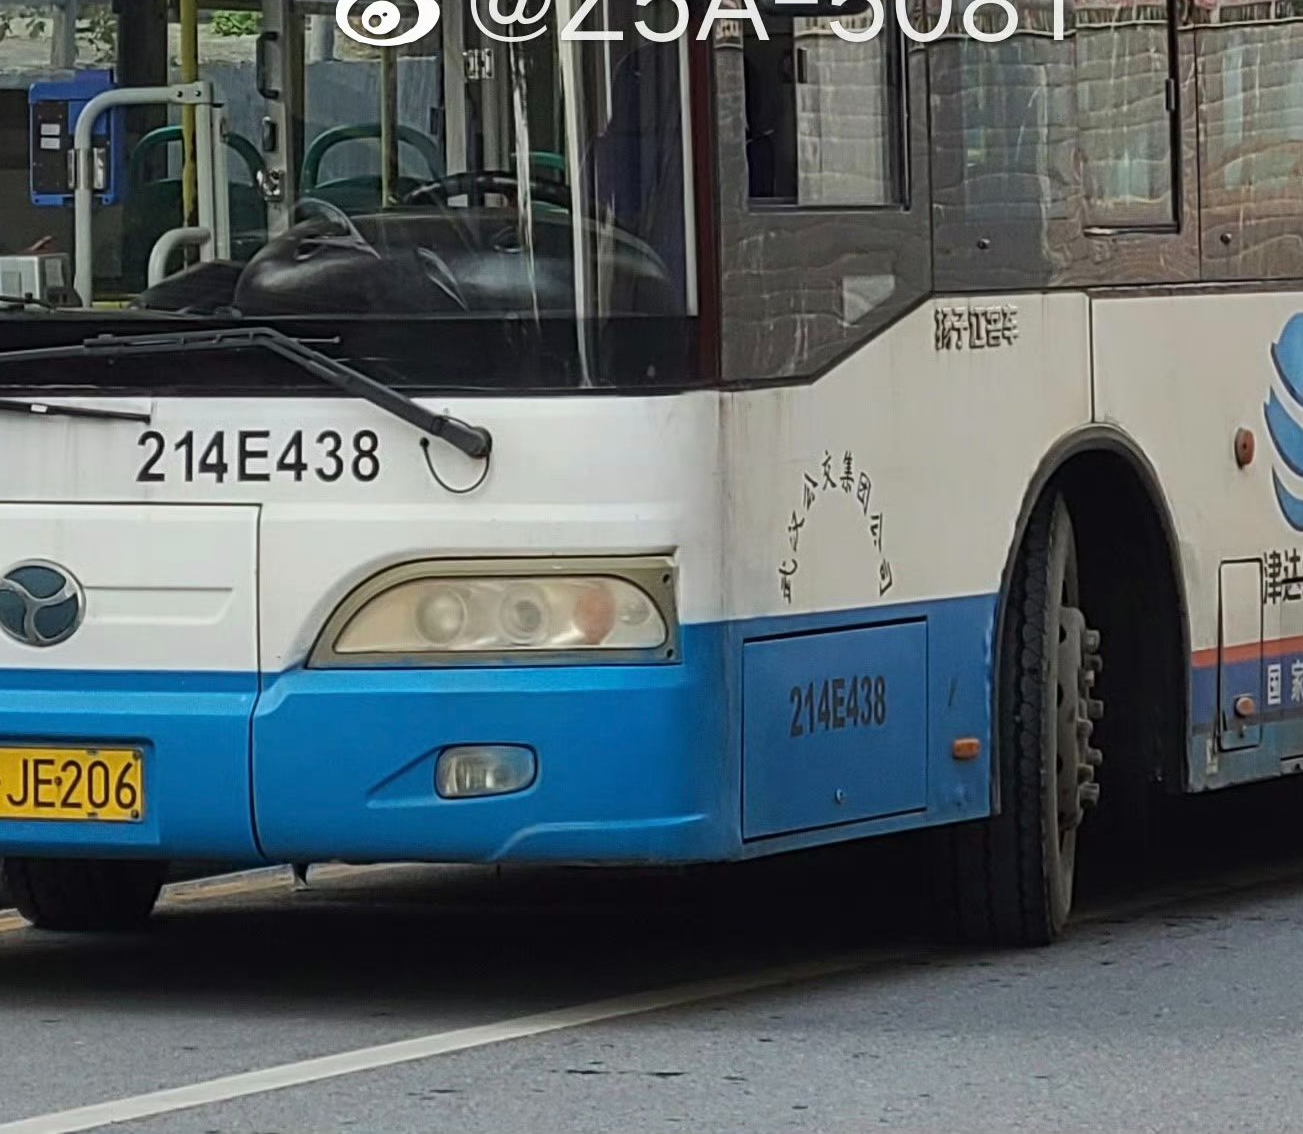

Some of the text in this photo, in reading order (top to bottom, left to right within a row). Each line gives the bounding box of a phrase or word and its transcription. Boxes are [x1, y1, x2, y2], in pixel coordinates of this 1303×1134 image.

[934, 306, 1019, 351] 扬子江客车
[136, 429, 382, 483] 214E438
[789, 674, 887, 738] 214E438
